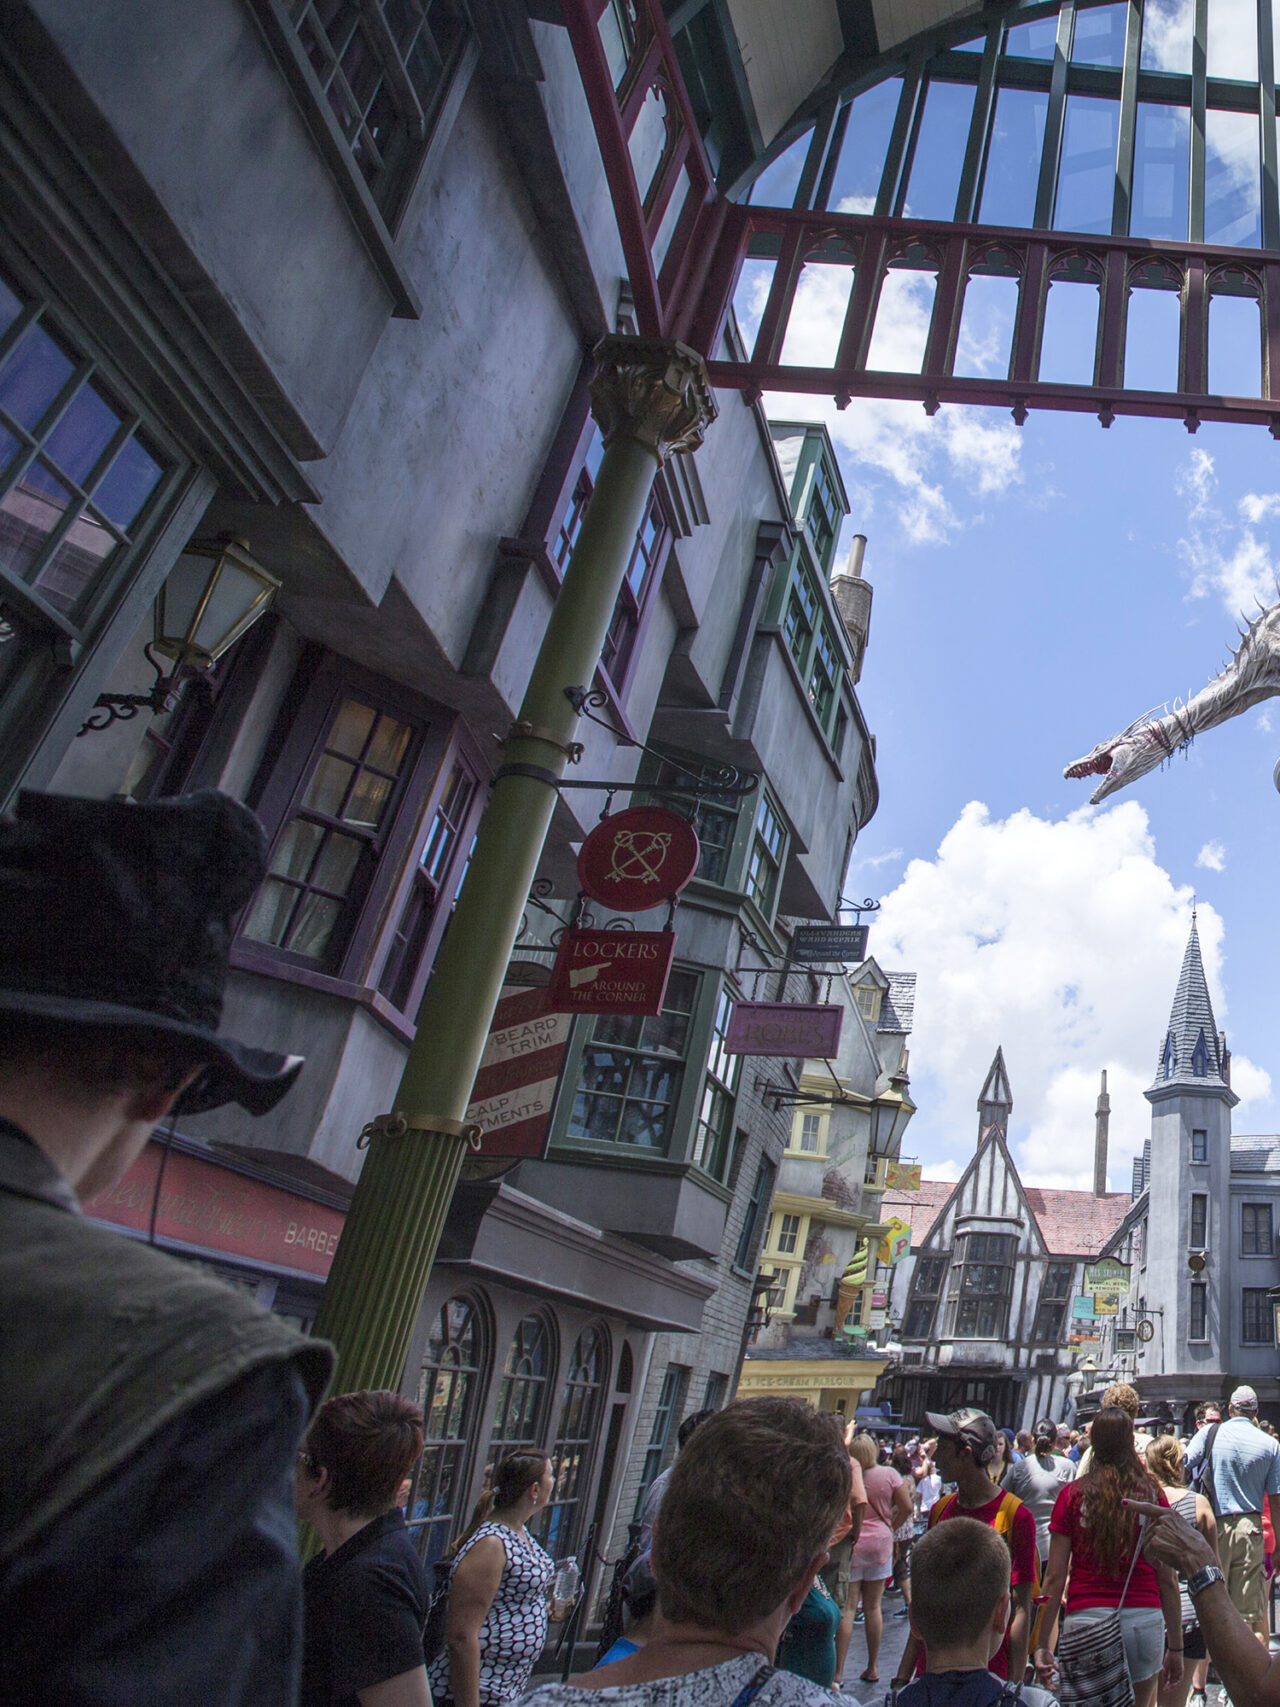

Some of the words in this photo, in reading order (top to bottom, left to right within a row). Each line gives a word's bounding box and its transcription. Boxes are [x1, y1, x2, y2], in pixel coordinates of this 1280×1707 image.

[573, 941, 660, 960] LOCKERS
[591, 981, 646, 992] AROUND
[572, 991, 594, 1002] THE
[596, 991, 648, 1003] CORNER
[495, 1018, 558, 1045] BEARD
[506, 1034, 552, 1055] TRIM
[466, 1098, 509, 1121] CALP
[282, 1221, 338, 1257] BARBE
[813, 1377, 855, 1387] PARLOUR
